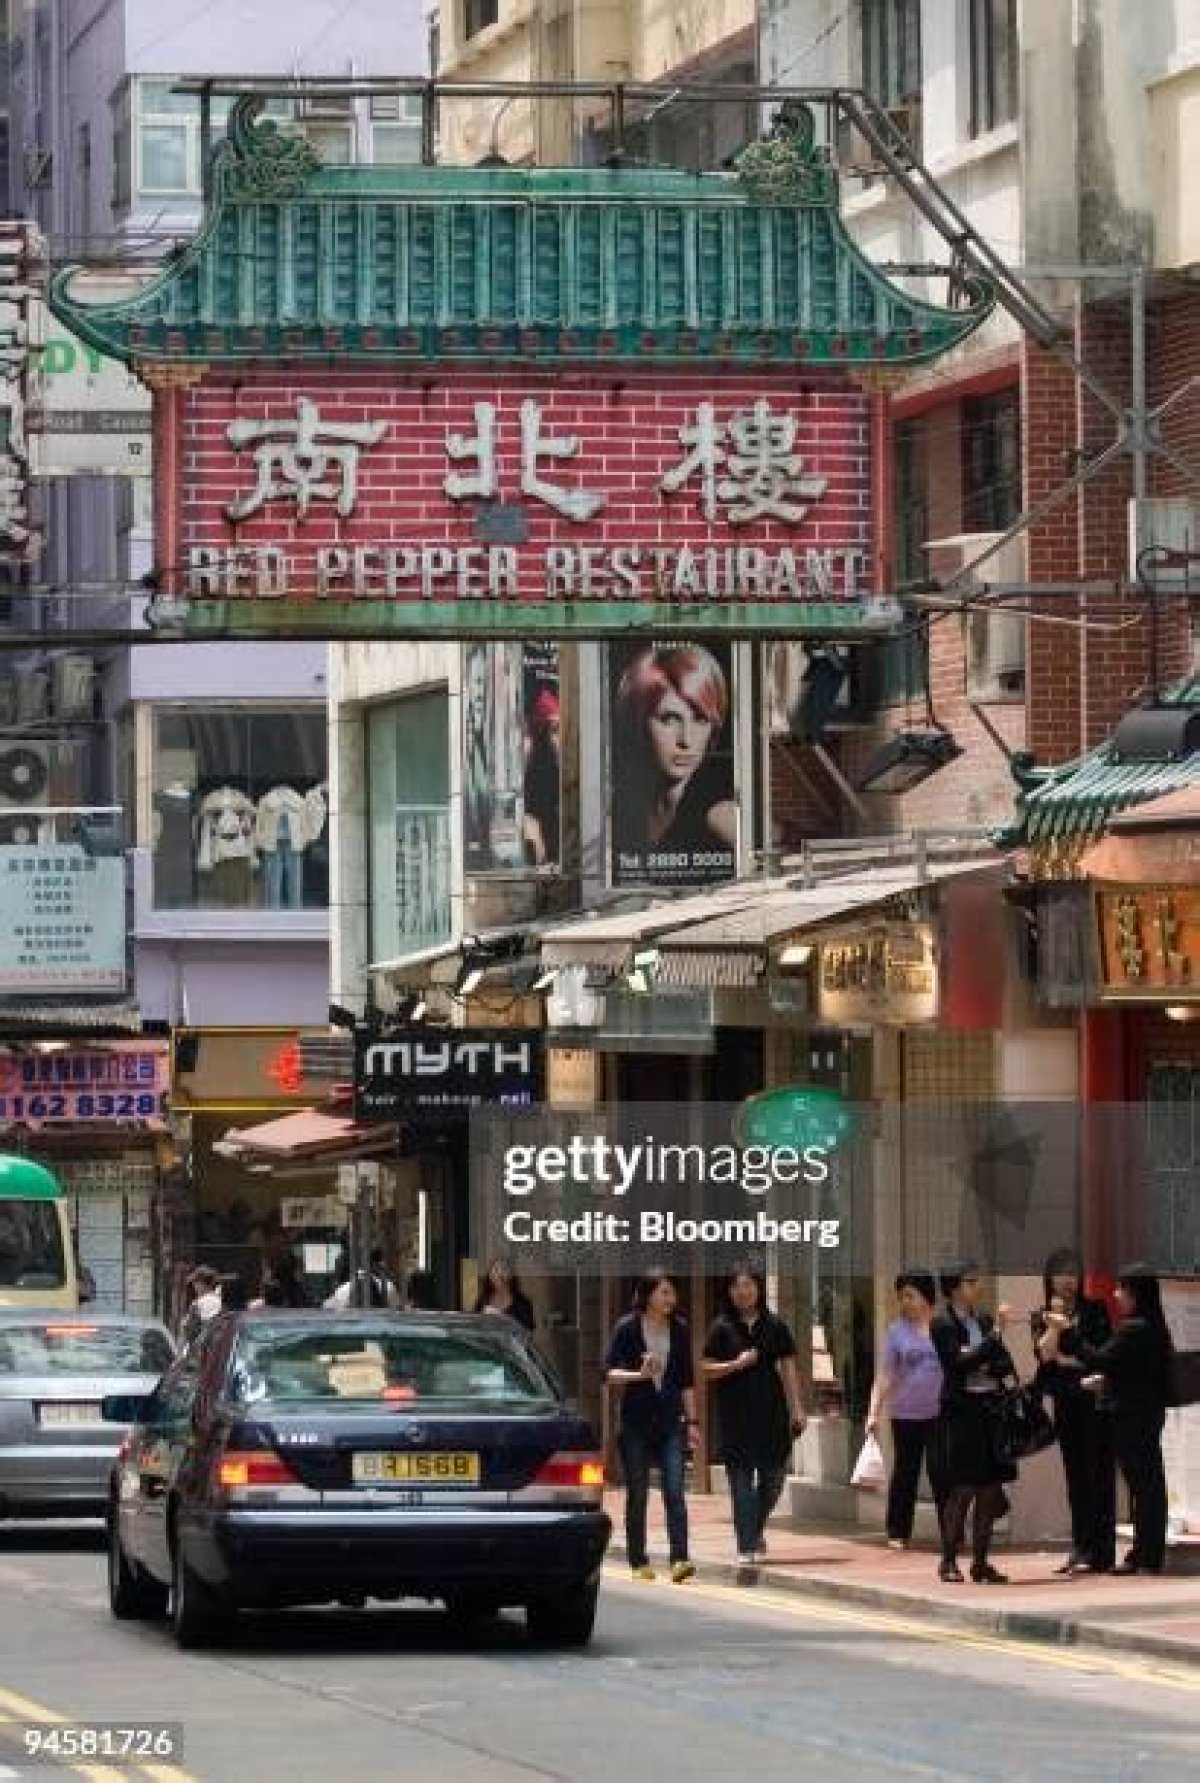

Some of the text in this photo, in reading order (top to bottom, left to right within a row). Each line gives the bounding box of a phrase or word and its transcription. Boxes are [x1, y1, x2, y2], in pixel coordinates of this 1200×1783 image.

[226, 396, 828, 523] 南北樓
[190, 547, 867, 597] RED PEPPER RESTAURANT
[366, 1042, 531, 1076] MYTH
[76, 1093, 155, 1116] 8328
